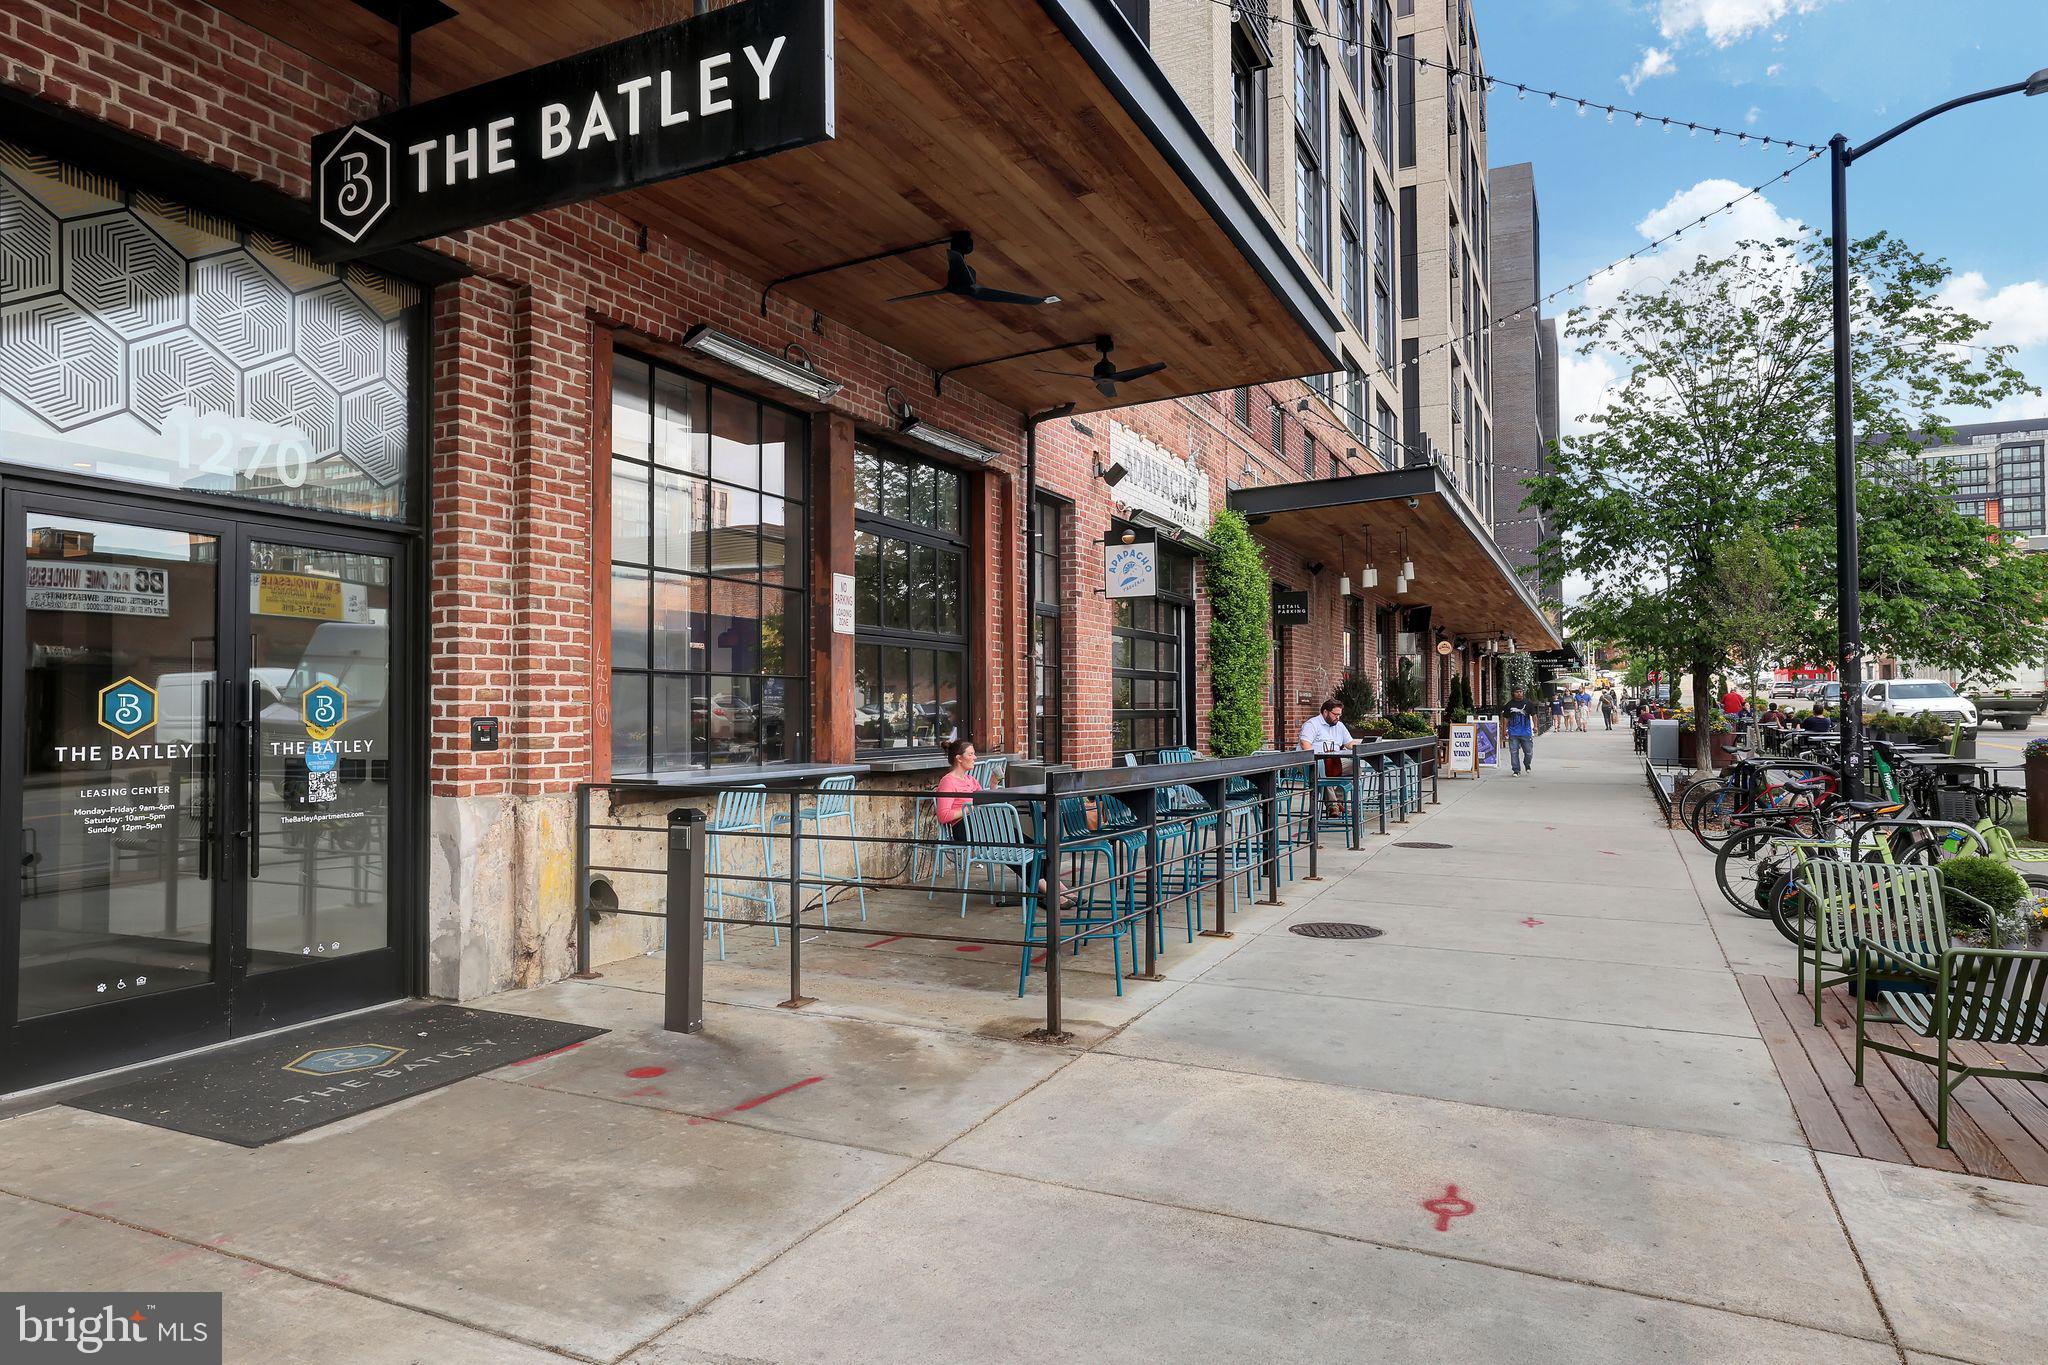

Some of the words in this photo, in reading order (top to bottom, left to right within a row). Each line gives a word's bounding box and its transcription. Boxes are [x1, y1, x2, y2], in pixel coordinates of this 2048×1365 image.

[408, 116, 517, 194] THE
[541, 35, 787, 160] BATLEY
[173, 417, 308, 488] 1270
[1169, 507, 1196, 527] TAQUERIA
[840, 582, 848, 593] NO
[835, 594, 854, 606] PARKING
[835, 608, 853, 618] LOADING
[839, 617, 849, 627] ZONE
[54, 746, 102, 762] THE
[111, 743, 193, 761] BATLEY
[270, 742, 306, 756] THE
[312, 739, 374, 754] BATLEY
[80, 787, 127, 798] LEASING
[131, 785, 170, 795] CENTER
[84, 815, 123, 825] Saturday:
[280, 811, 365, 824] TheBatleyApartments.com
[87, 825, 118, 835] Sunday
[283, 1079, 371, 1104] THE
[374, 1038, 498, 1078] BATLEY
